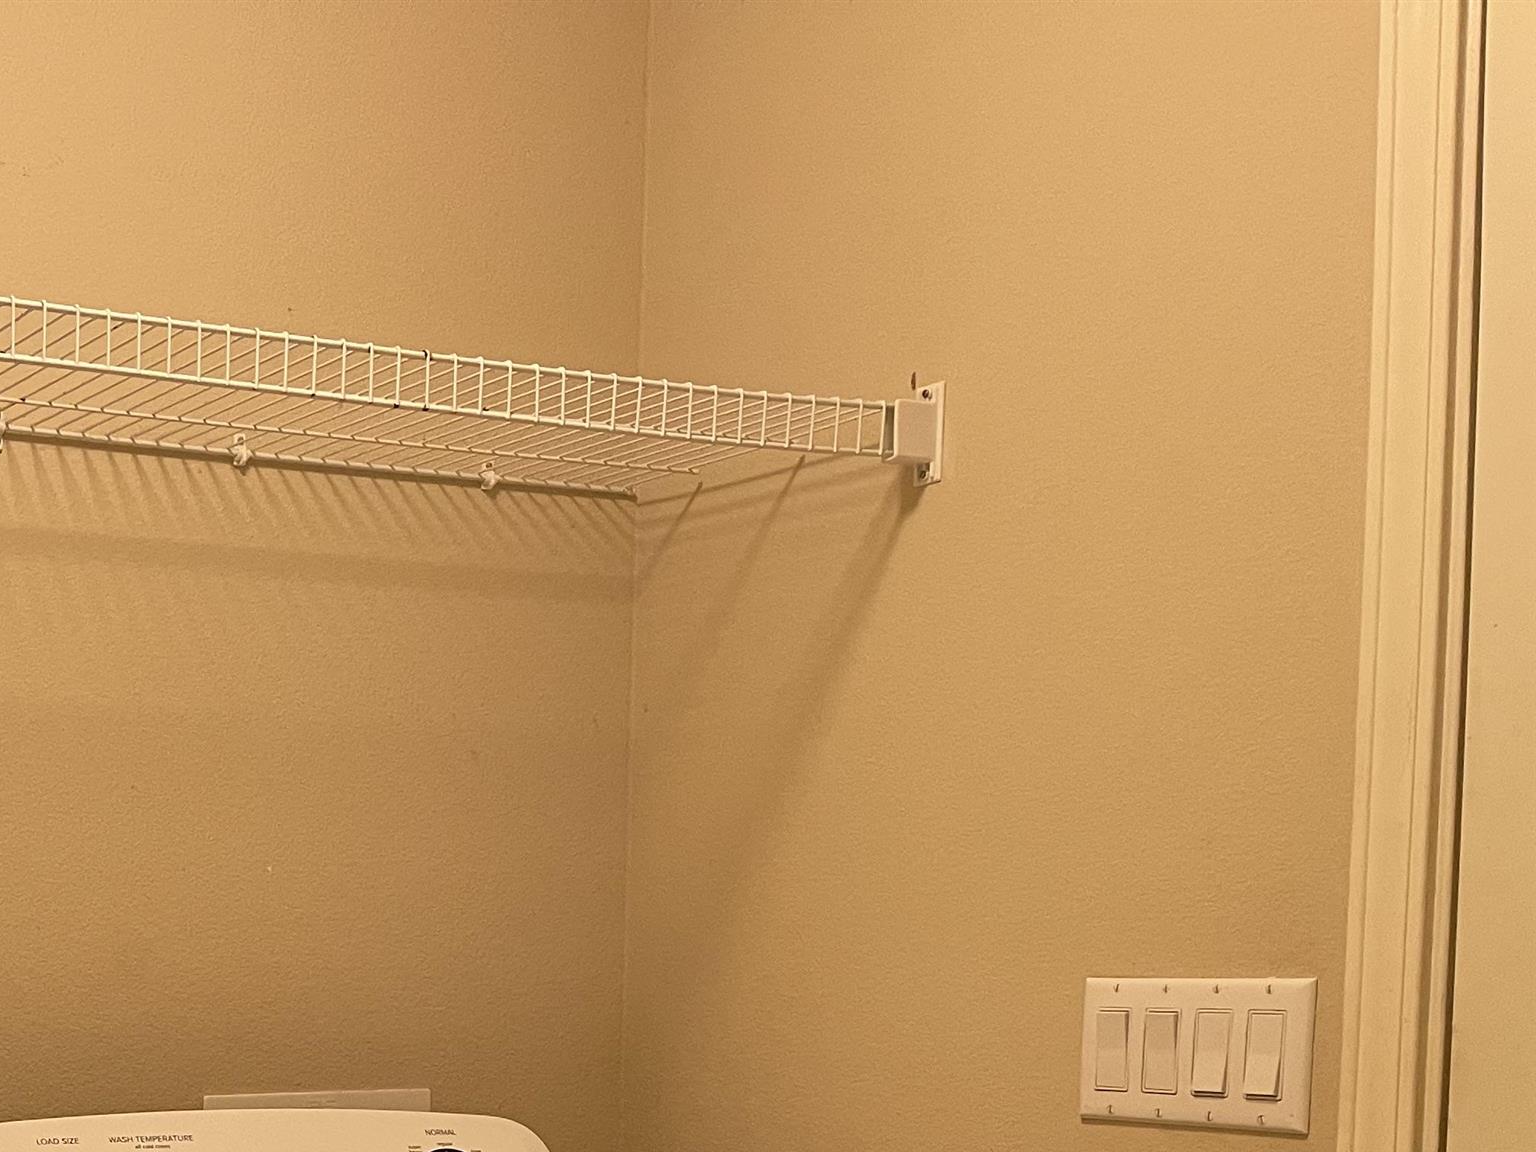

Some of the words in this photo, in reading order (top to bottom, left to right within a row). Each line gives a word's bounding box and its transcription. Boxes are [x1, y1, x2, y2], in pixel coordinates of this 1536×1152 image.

[36, 1137, 60, 1146] LOAD
[61, 1137, 80, 1145] SIZE
[108, 1135, 134, 1144] WASH
[135, 1134, 194, 1143] TEMPERATURE
